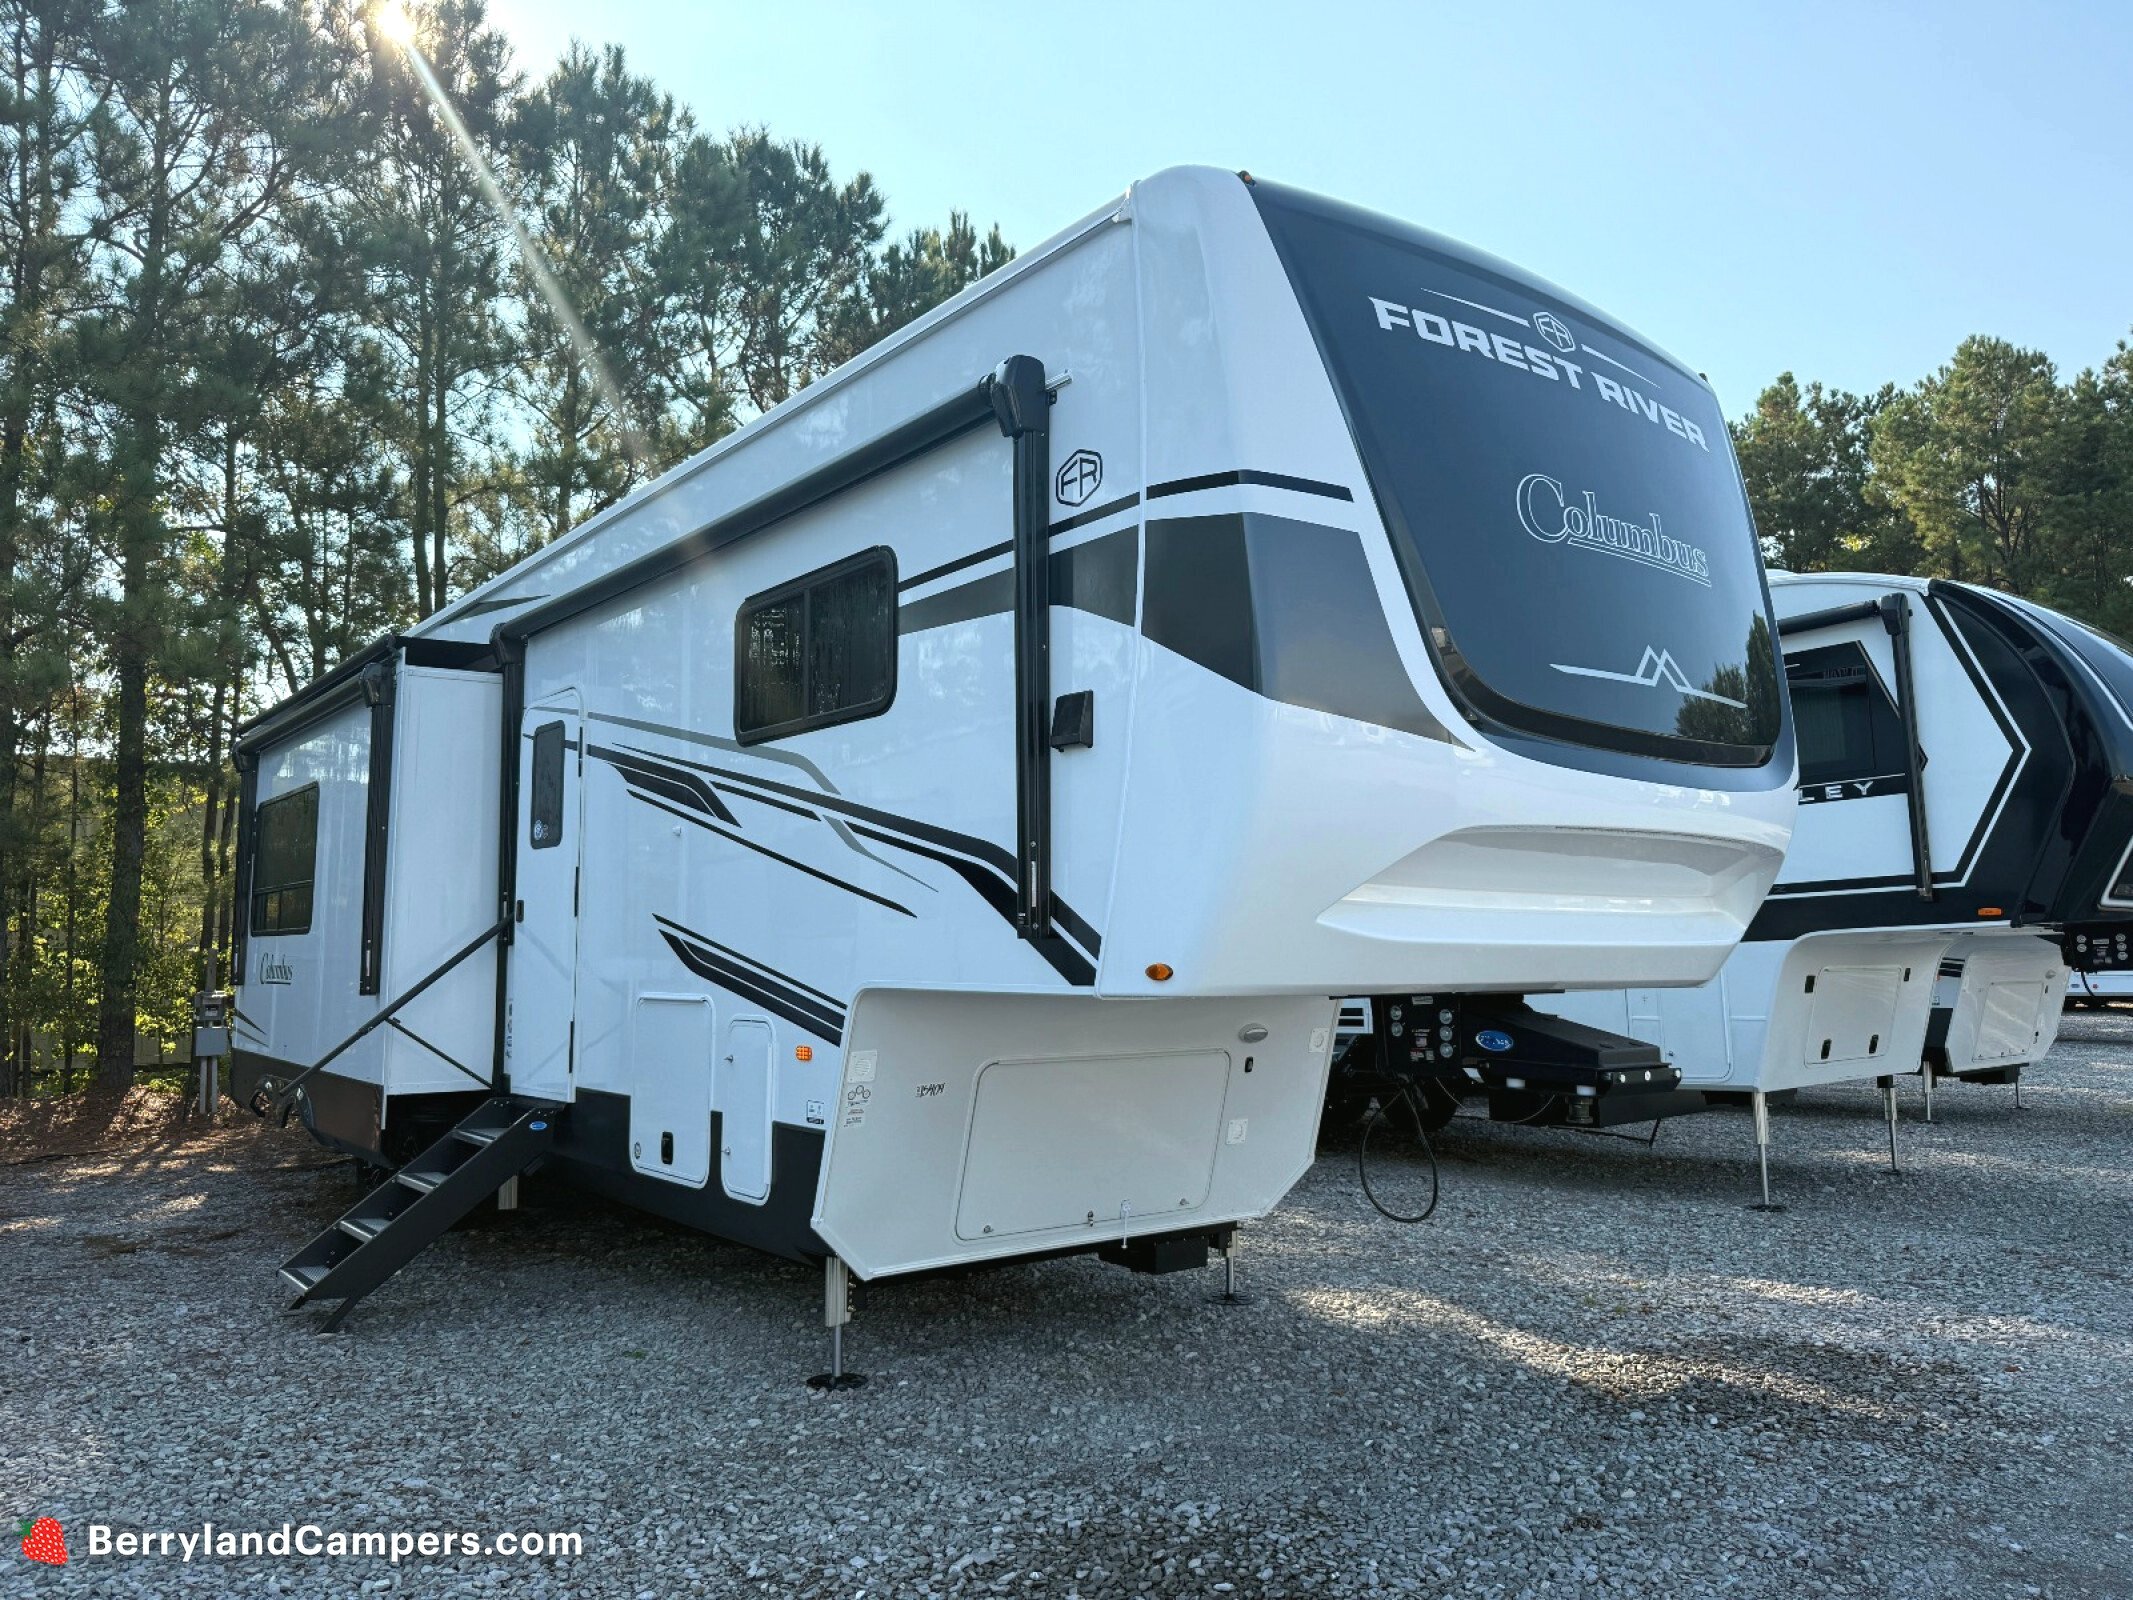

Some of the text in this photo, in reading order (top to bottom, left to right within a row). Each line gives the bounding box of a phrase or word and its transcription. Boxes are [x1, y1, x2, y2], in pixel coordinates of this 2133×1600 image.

[1368, 296, 1709, 452] FOREST RIVER
[1516, 473, 1710, 577] Columbus
